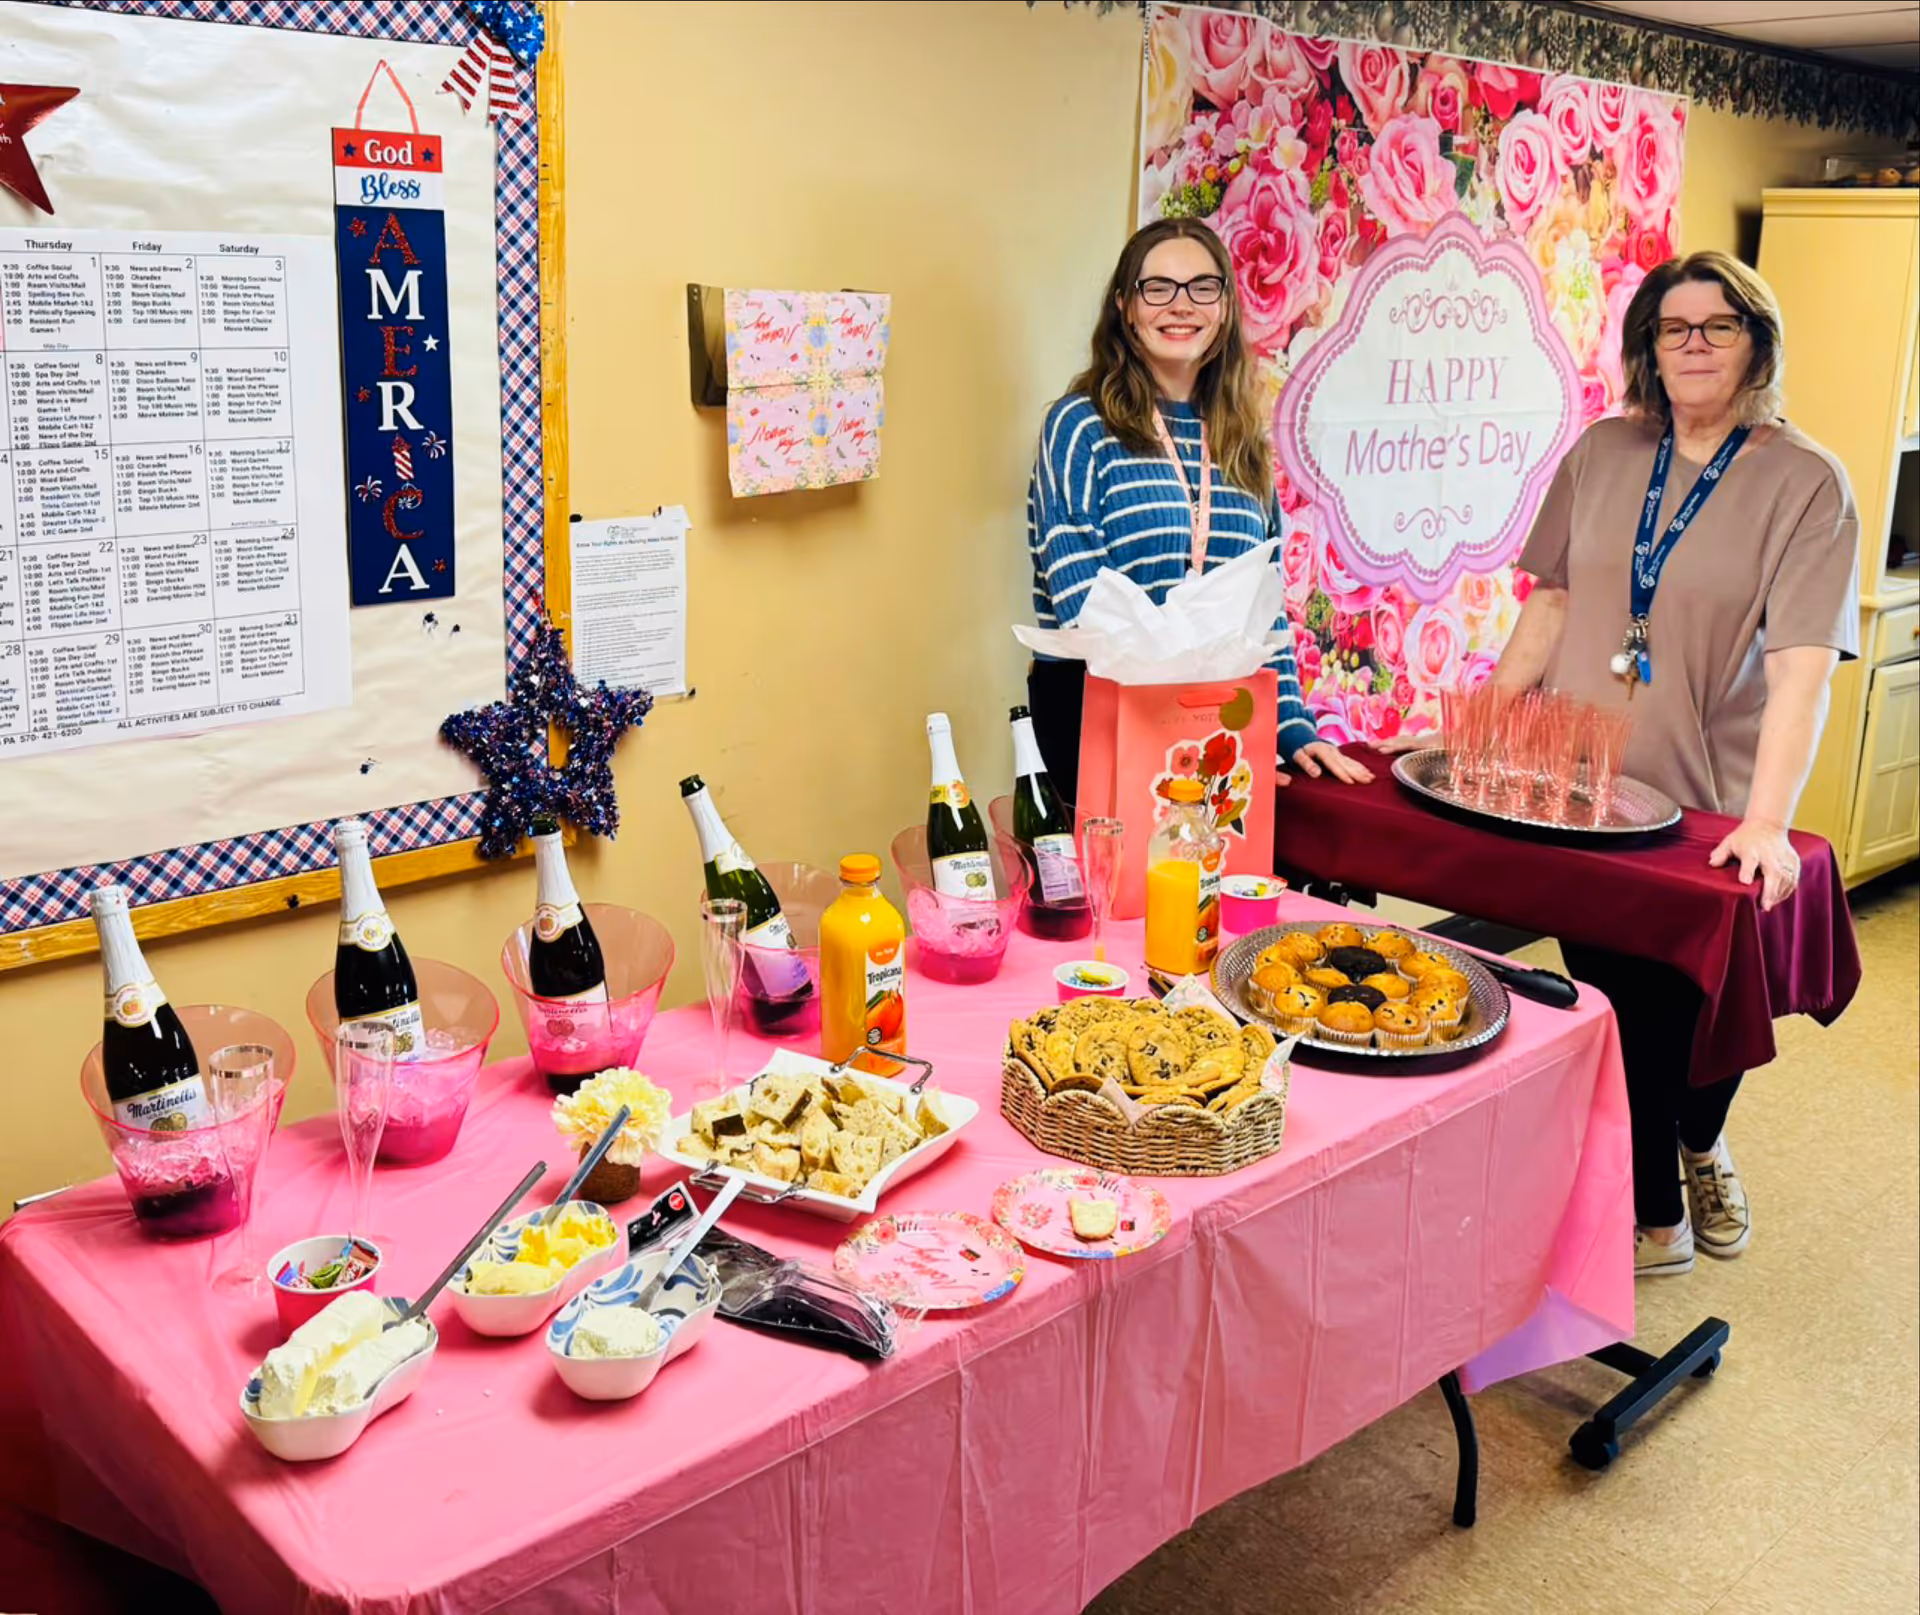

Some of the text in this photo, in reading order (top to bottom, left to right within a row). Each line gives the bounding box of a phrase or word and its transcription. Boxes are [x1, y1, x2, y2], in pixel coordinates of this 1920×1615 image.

[364, 139, 413, 165] God
[361, 172, 421, 204] Bless
[25, 239, 72, 251] Thursday
[132, 241, 162, 253] Friday
[219, 244, 259, 255] Saturday
[91, 257, 96, 267] 1
[185, 258, 193, 269] 2
[275, 260, 282, 271] 3
[96, 353, 103, 364] 8
[191, 352, 198, 363] 9
[274, 351, 287, 362] 10
[1384, 356, 1509, 405] HAPPY
[365, 211, 430, 593] AMERICA
[189, 445, 202, 455] 16
[1479, 421, 1532, 476] Day
[95, 450, 109, 460] 15
[193, 535, 207, 545] 23
[99, 542, 113, 553] 22
[198, 623, 212, 634] 30
[105, 634, 120, 646] 29
[5, 644, 21, 656] 28
[117, 698, 281, 729] ALL ACTIVITIES ARE SUBJECT TO CHANGE
[3, 736, 16, 745] PA
[41, 727, 83, 739] 421-6200
[867, 966, 902, 984] Tropicana
